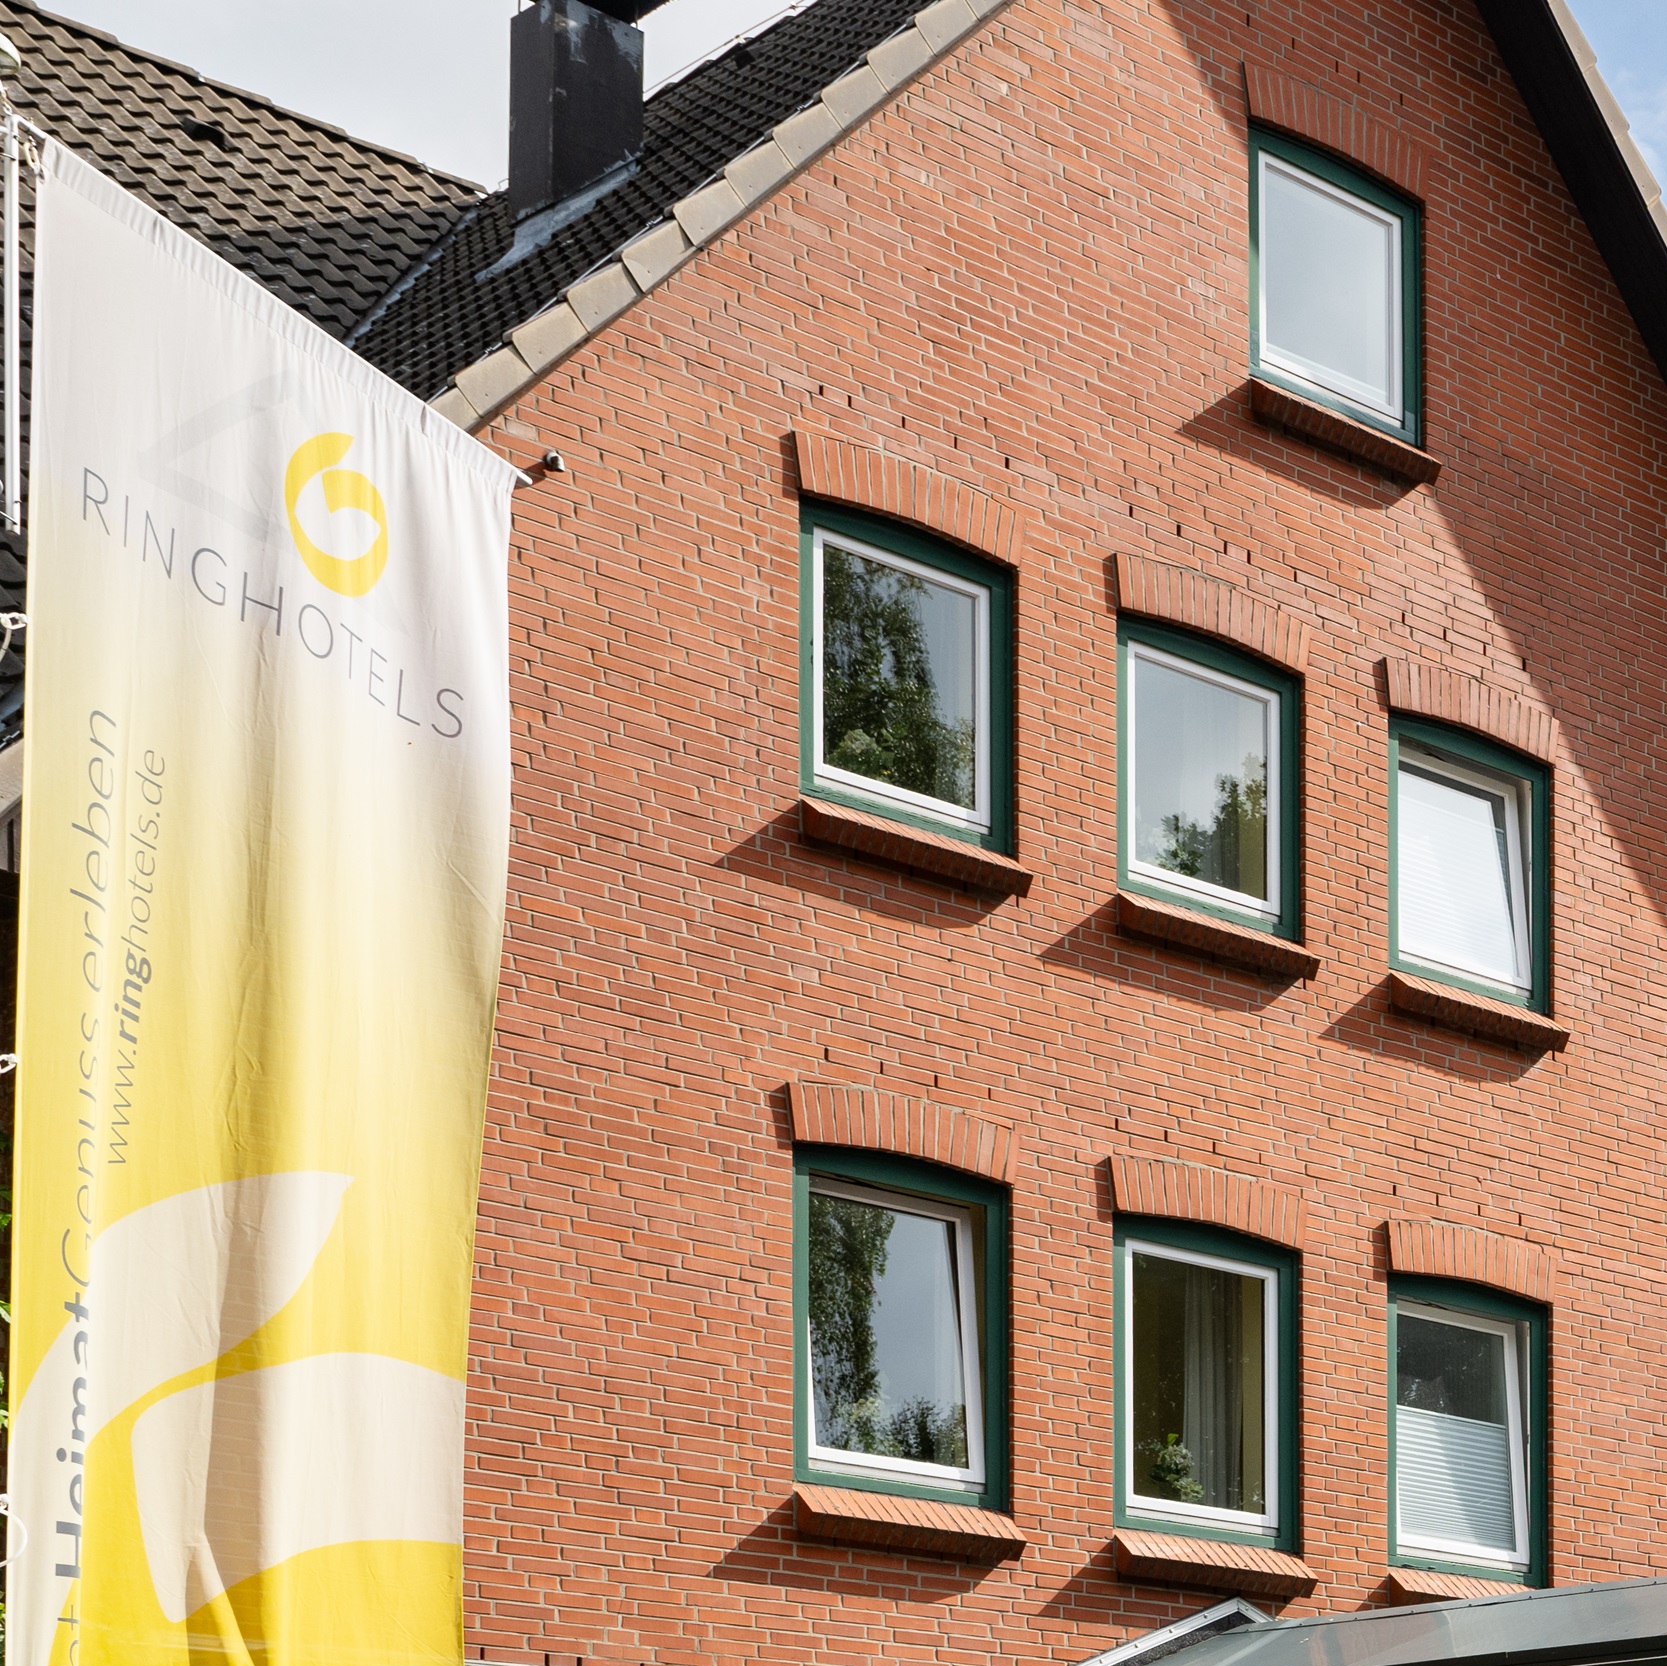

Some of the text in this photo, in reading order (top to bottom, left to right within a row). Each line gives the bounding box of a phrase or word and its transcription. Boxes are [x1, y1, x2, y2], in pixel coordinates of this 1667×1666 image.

[82, 466, 464, 739] RINGHOTELS
[69, 708, 117, 994] erleben
[107, 749, 166, 1165] www.ringhotels.de
